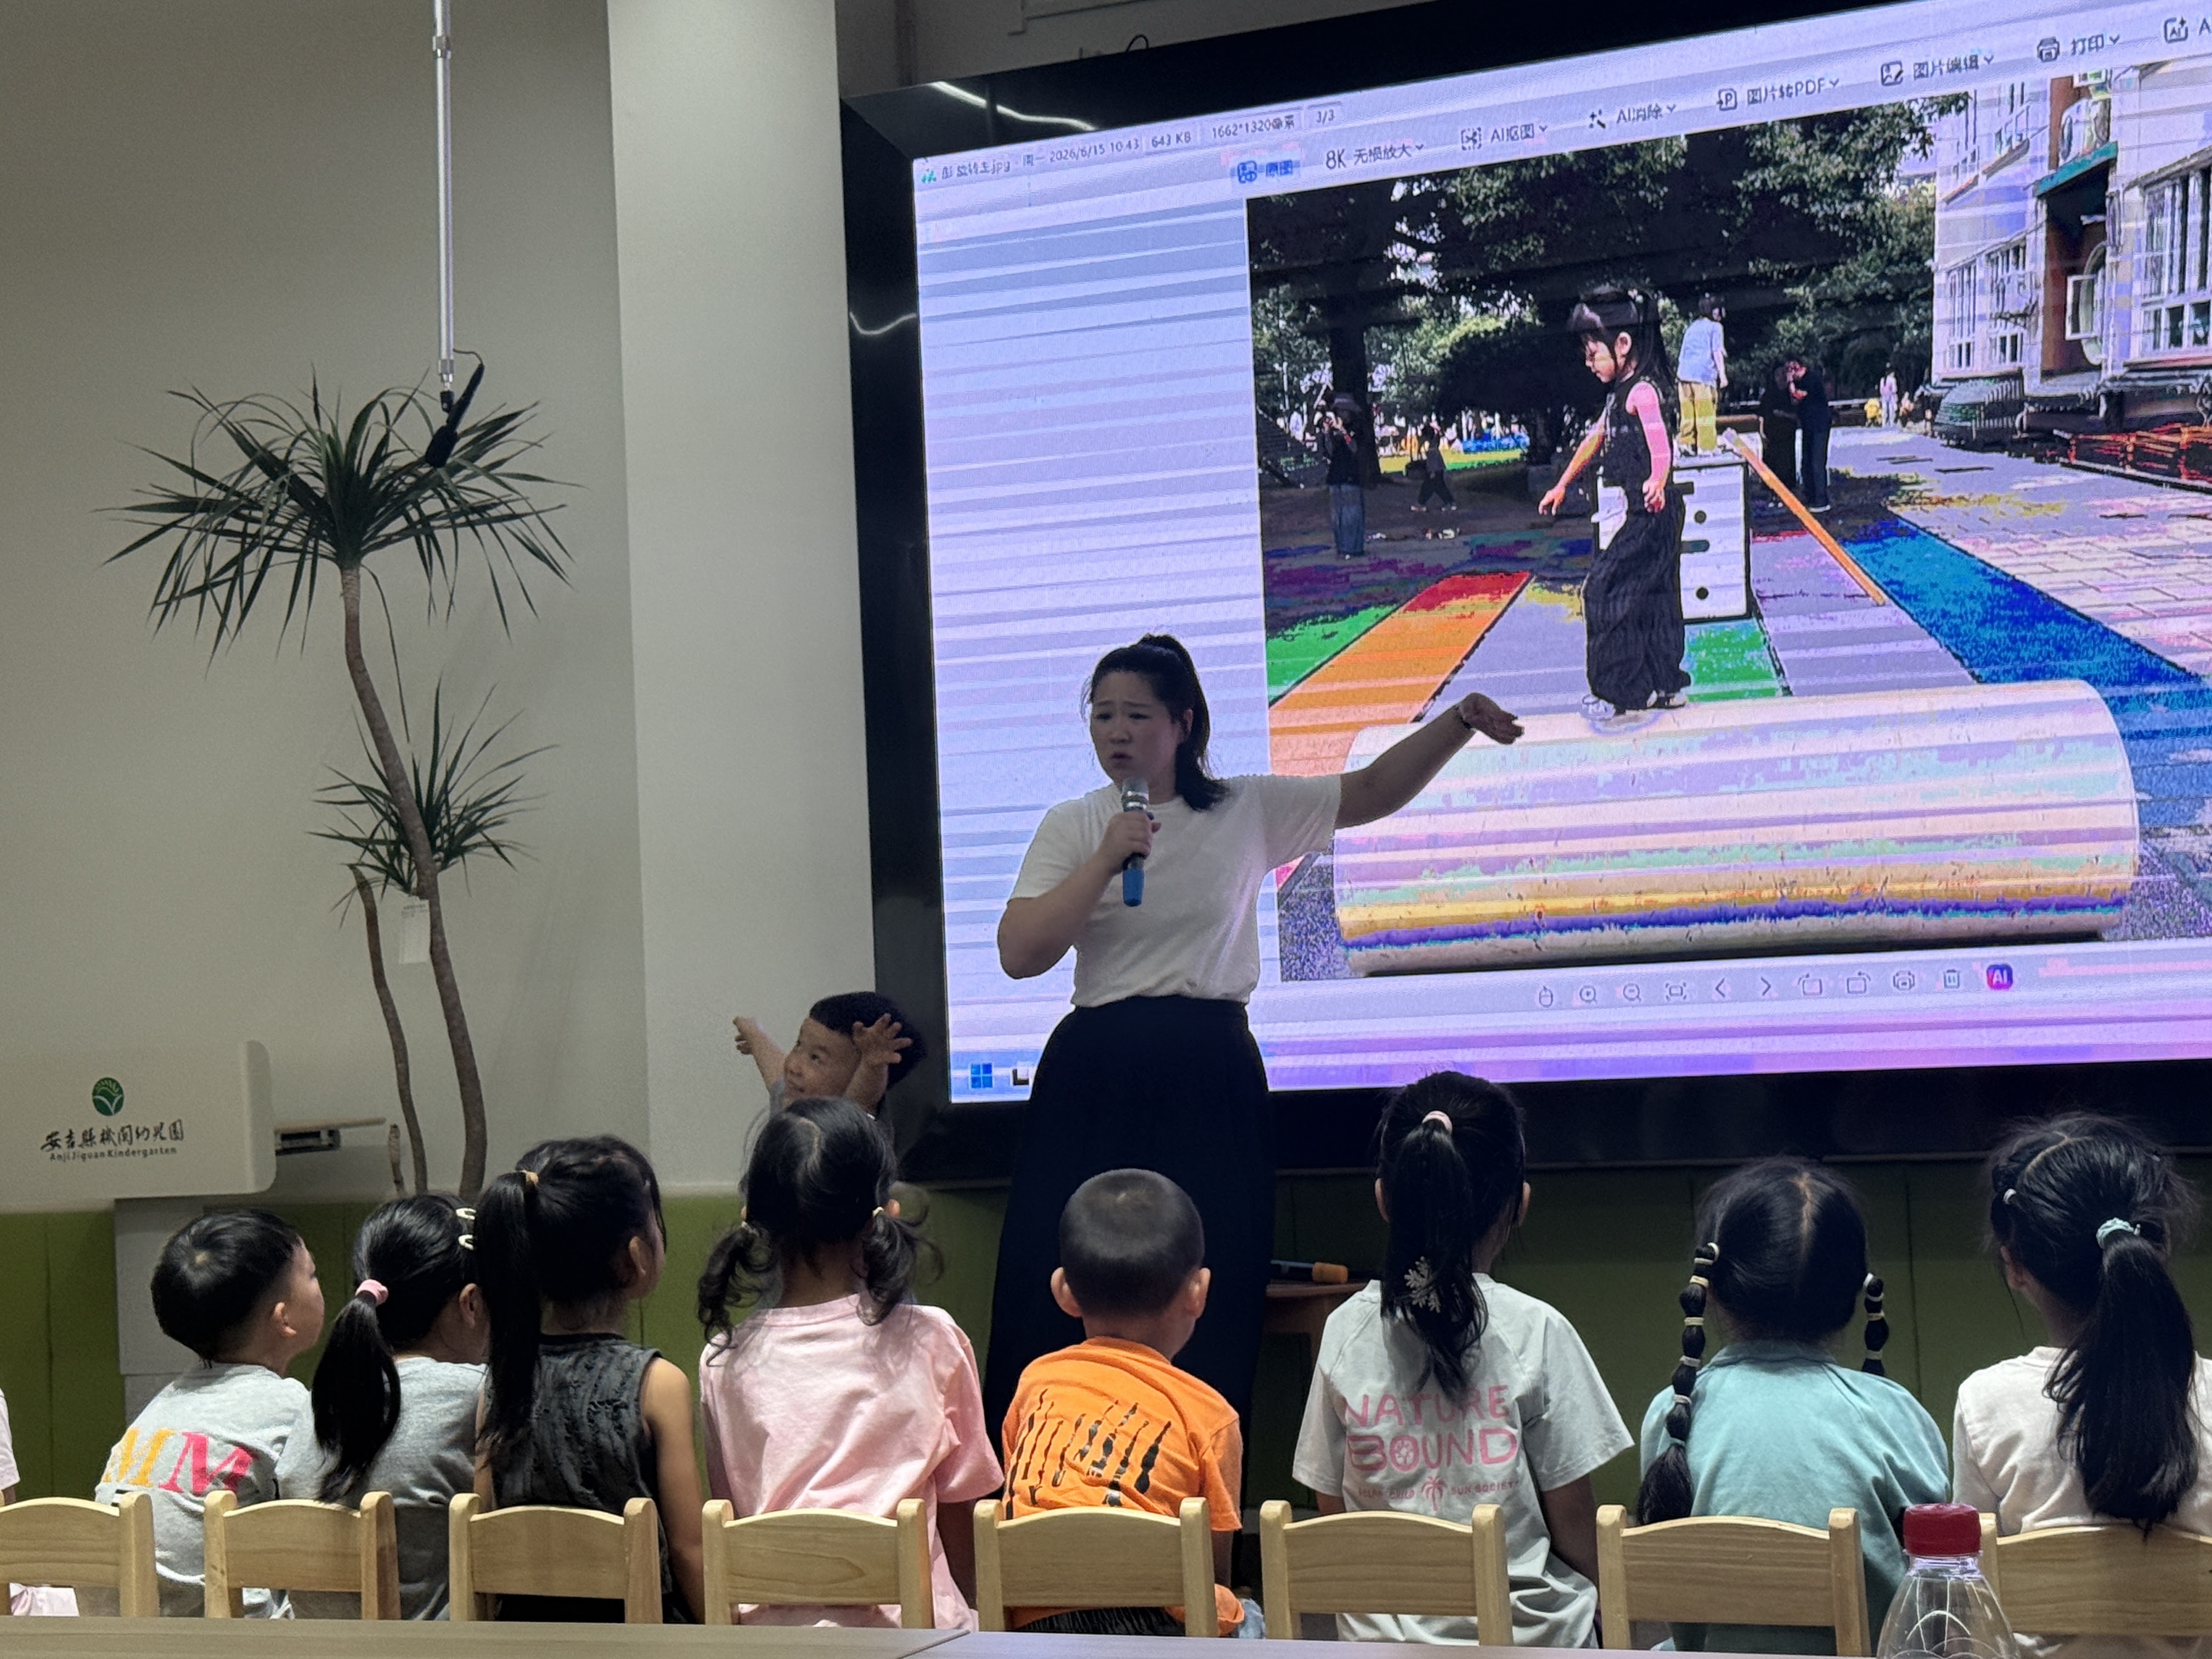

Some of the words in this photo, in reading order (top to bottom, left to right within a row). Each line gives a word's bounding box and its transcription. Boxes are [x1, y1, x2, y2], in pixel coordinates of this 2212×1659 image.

[2071, 33, 2104, 55] 打印
[1316, 109, 1335, 125] 3/3
[1176, 131, 1192, 144] KB
[1325, 148, 1347, 170] 8K
[1353, 143, 1414, 165] 无损放大
[1993, 968, 2008, 985] AI
[1347, 1428, 1519, 1472] BOUND
